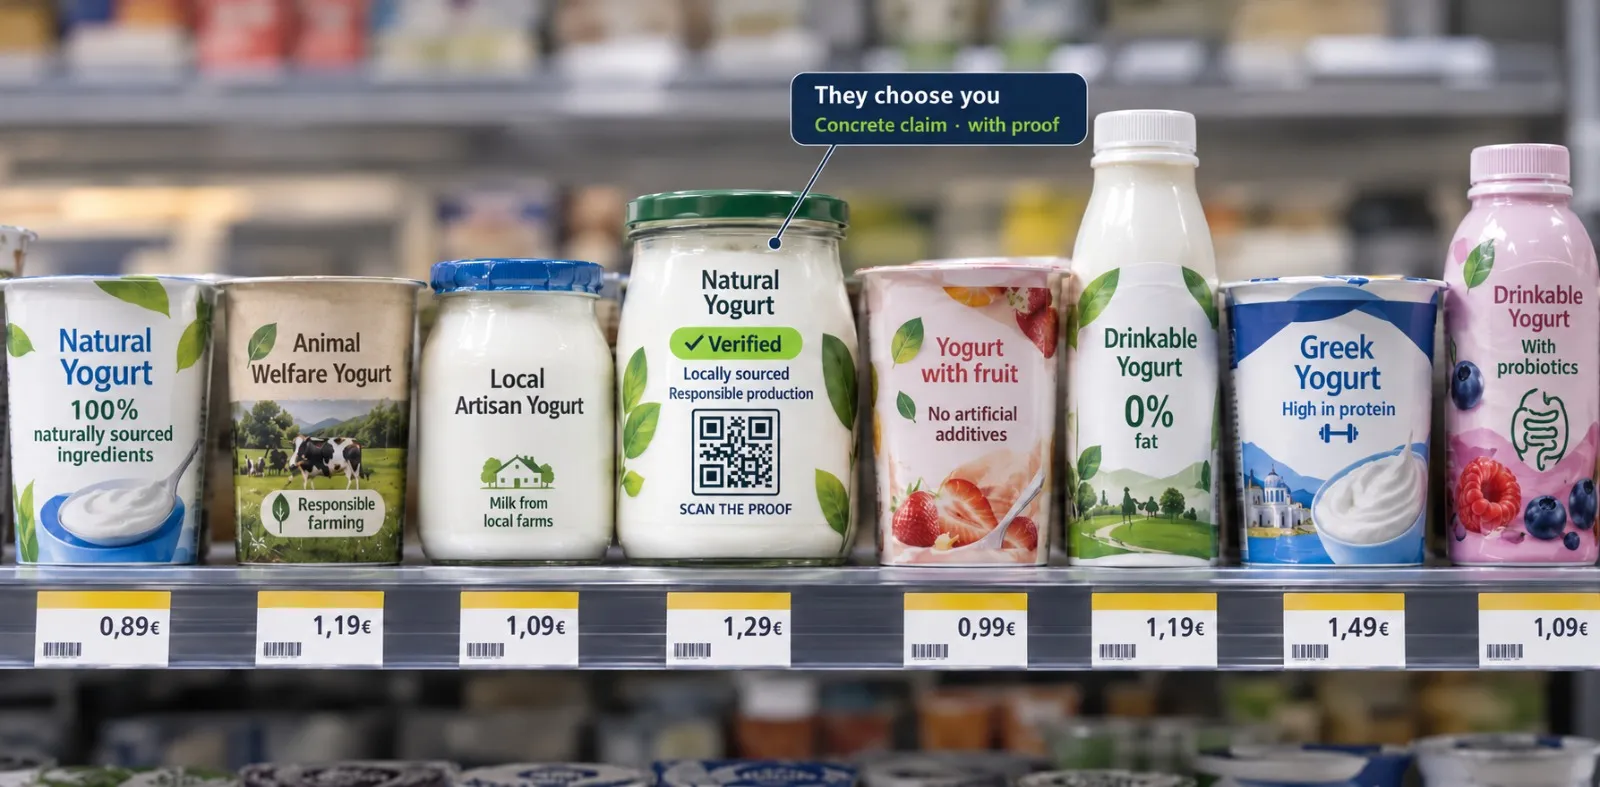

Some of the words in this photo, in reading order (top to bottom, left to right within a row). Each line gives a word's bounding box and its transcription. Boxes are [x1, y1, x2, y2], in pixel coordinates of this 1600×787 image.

[703, 269, 778, 289] Natural
[1495, 285, 1582, 304] Drinkable
[704, 295, 774, 319] Yogurt
[1509, 309, 1570, 332] Yogurt
[60, 327, 151, 352] Natural
[293, 332, 360, 352] Animal
[709, 335, 781, 352] Verified
[1105, 327, 1197, 348] Drinkable
[1301, 334, 1374, 359] Greek
[1522, 339, 1555, 353] With
[937, 337, 1003, 361] Yogurt
[61, 359, 152, 392] Yogurt
[252, 363, 327, 383] Welfare
[333, 363, 391, 387] Yogurt
[492, 368, 544, 388] Local
[684, 366, 731, 384] Locally
[736, 366, 789, 380] sourced
[922, 363, 967, 383] with
[974, 363, 1018, 383] fruit
[1117, 356, 1182, 382] Yogurt
[1498, 358, 1578, 378] probiotics
[1295, 365, 1381, 396] Yogurt
[670, 387, 743, 402] Responsible
[747, 387, 813, 402] production
[72, 399, 138, 420] 100%
[455, 395, 521, 414] Artisan
[527, 396, 583, 419] Yogurt
[929, 407, 950, 421] No
[955, 406, 1017, 421] artificial
[1125, 395, 1173, 427] 0%
[1283, 401, 1316, 419] High
[1322, 401, 1334, 415] in
[1340, 401, 1395, 419] protein
[35, 425, 105, 446] naturally
[111, 425, 172, 441] sourced
[936, 426, 1007, 441] additives
[1135, 433, 1158, 449] fat
[59, 446, 153, 466] ingredients
[299, 496, 375, 514] Responsible
[491, 496, 516, 509] Milk
[520, 496, 547, 509] from
[680, 504, 714, 514] SCAN
[719, 504, 744, 515] THE
[749, 504, 792, 515] PROOF
[308, 515, 363, 532] farming
[484, 514, 513, 527] local
[517, 514, 553, 527] farms
[100, 616, 159, 639] 0,89€
[314, 615, 371, 638] 1,19€
[507, 616, 565, 639] 1,09€
[724, 617, 782, 639] 1,29€
[958, 617, 1015, 640] 0,99€
[1147, 617, 1204, 640] 1,19€
[1329, 617, 1388, 640] 1,49€
[1535, 618, 1587, 640] 1,09€
